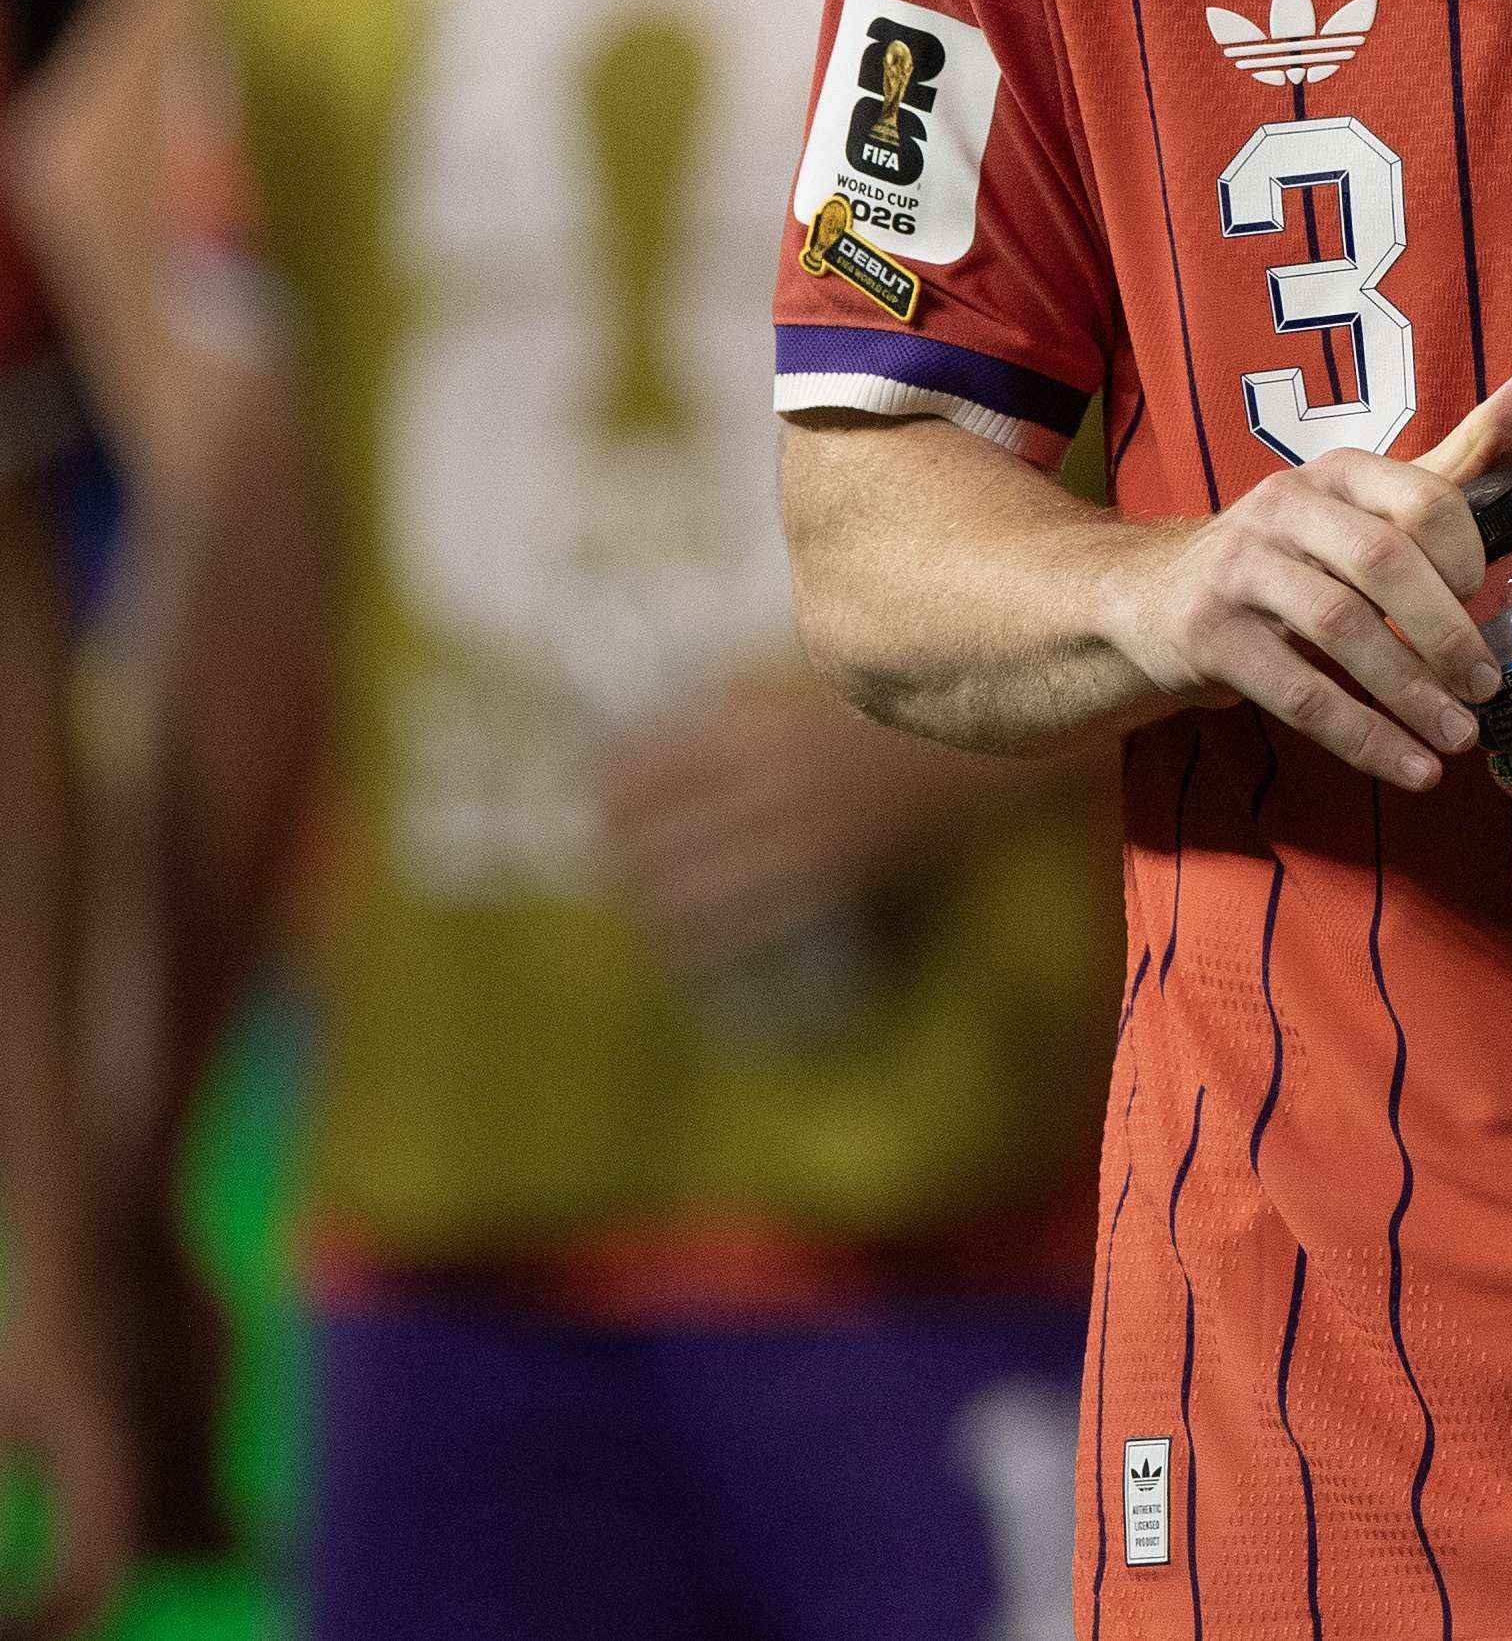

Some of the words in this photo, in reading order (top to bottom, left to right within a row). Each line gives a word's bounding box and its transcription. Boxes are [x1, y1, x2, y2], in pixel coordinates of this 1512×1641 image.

[862, 142, 900, 172] FIFA
[837, 174, 884, 201] WORLD
[888, 193, 919, 210] CUP
[833, 193, 916, 235] 026
[838, 238, 911, 295] DEBUT
[1216, 115, 1417, 468] 3
[1132, 1504, 1162, 1515] AUTHENTIC
[1134, 1520, 1160, 1531] LICENSED
[1136, 1536, 1160, 1547] PRODUCT
